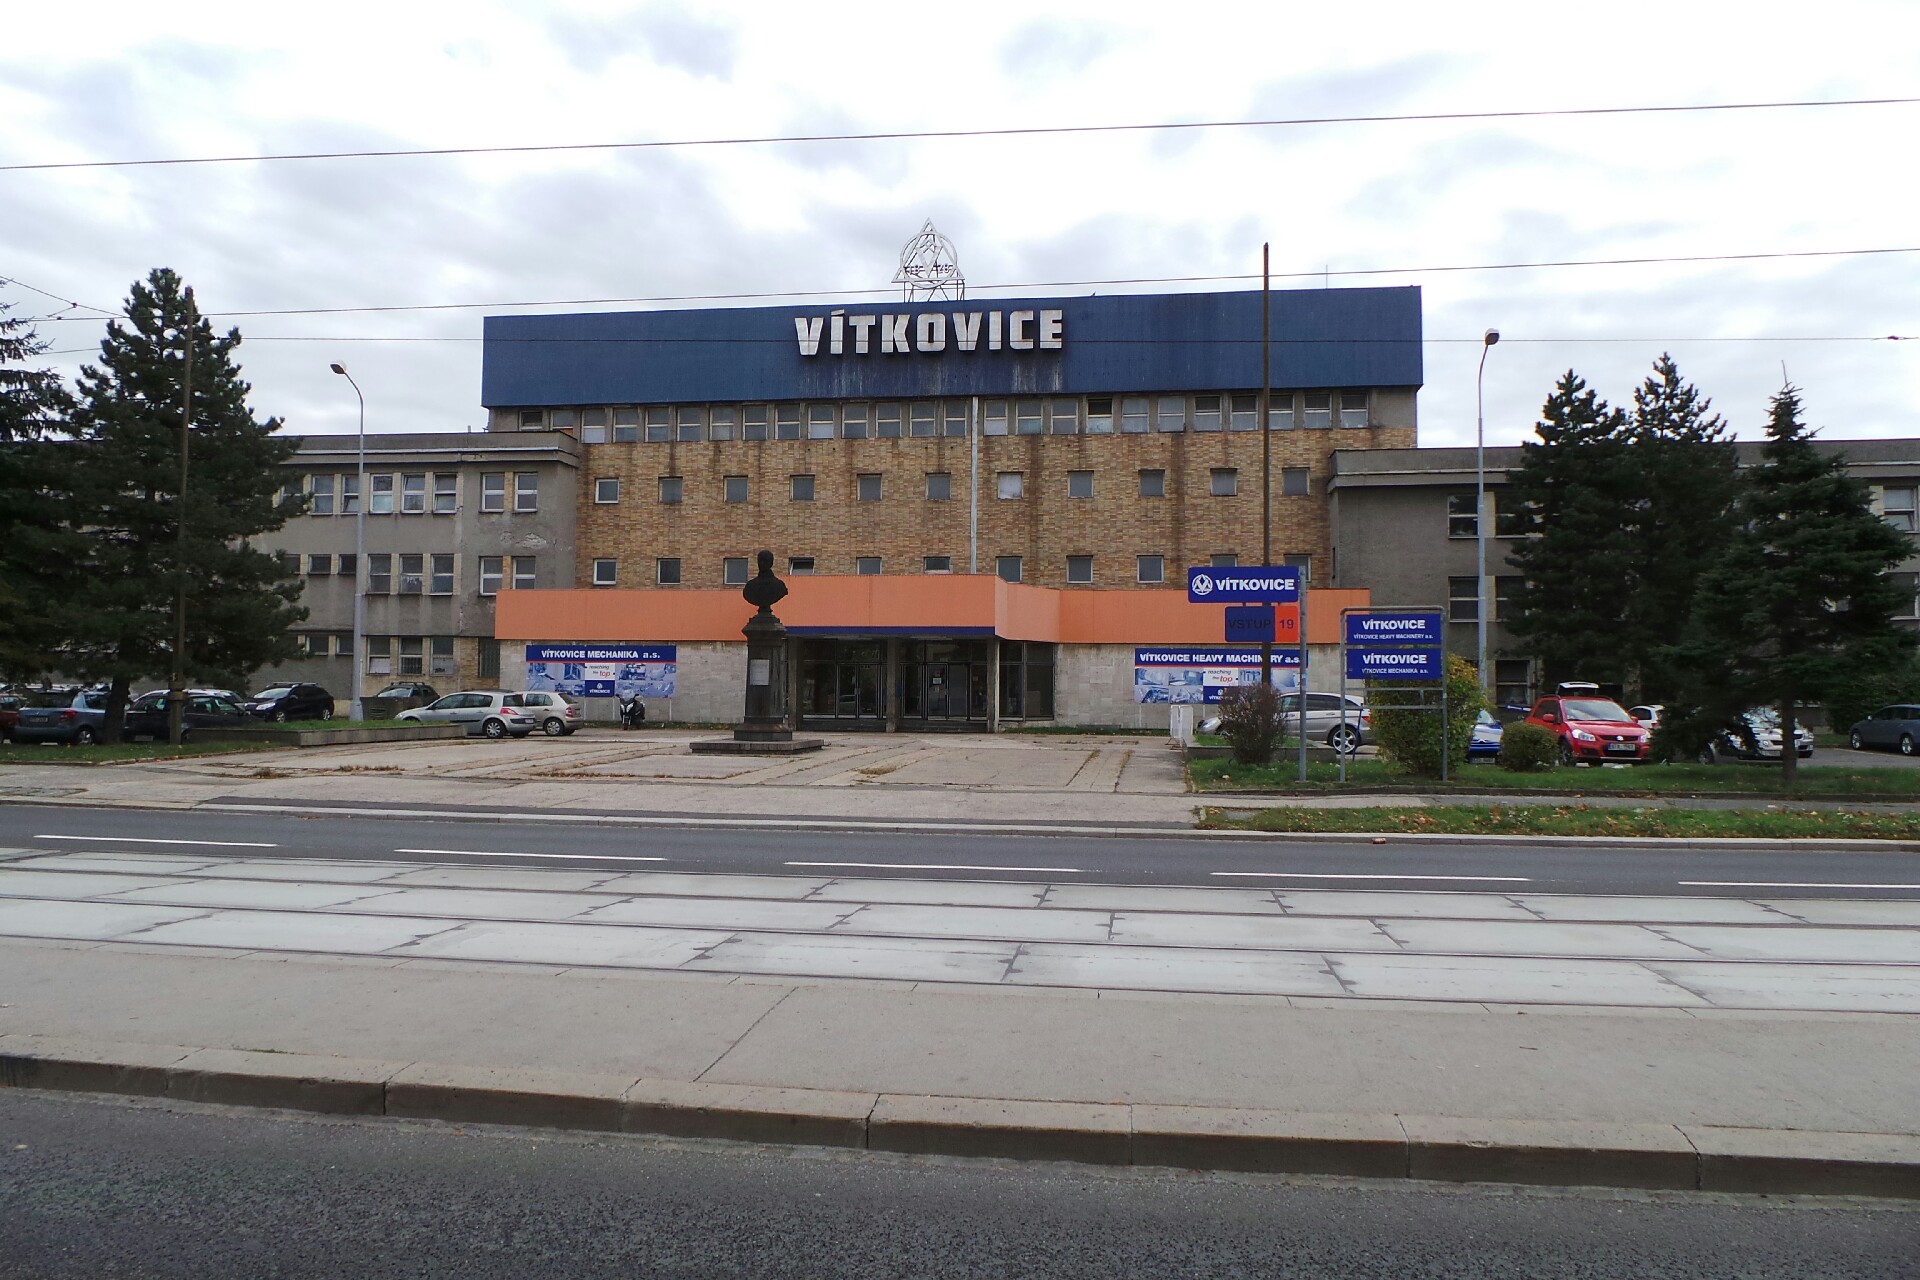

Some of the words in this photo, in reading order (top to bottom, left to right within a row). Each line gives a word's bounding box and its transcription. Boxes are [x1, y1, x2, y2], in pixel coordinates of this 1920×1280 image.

[794, 309, 1062, 356] VÍTKOVICE
[1216, 577, 1295, 590] VÍTKOVICE
[1229, 619, 1270, 629] VSTUP
[1280, 619, 1294, 629] 19
[1362, 619, 1426, 630] VÍTKOVICE
[542, 648, 586, 658] VÍTKOVICE
[1139, 652, 1190, 663] VÍTKOVICE
[1192, 654, 1223, 663] HEAVY
[1227, 654, 1282, 663] MACHINRY
[1362, 652, 1427, 664] VÍTKOVICE
[1220, 675, 1233, 683] top
